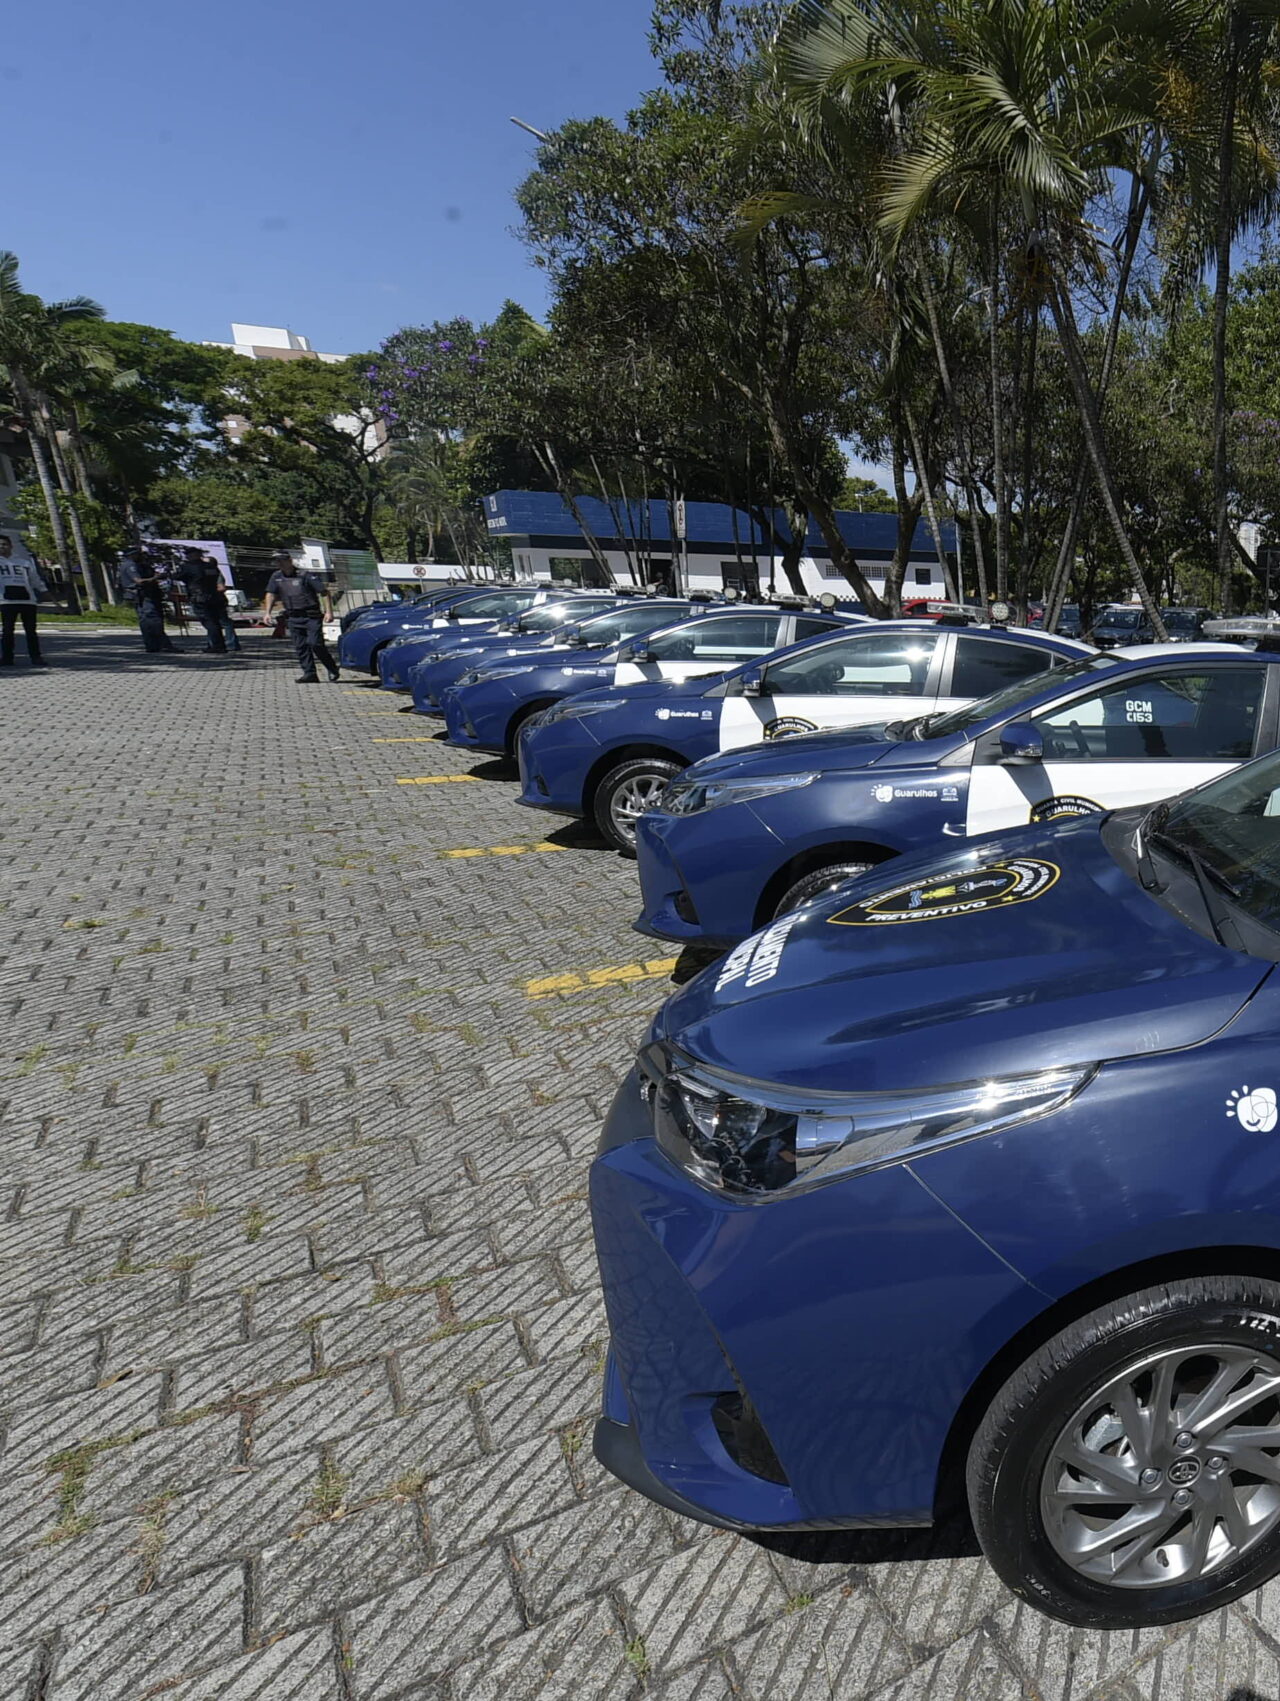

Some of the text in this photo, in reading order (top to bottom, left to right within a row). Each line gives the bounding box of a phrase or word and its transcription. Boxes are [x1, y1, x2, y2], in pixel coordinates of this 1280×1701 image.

[1125, 700, 1152, 713] GCM
[894, 787, 938, 798] Guarulhos
[1045, 805, 1091, 817] GUARULHO
[865, 901, 987, 921] PREVENTIVO
